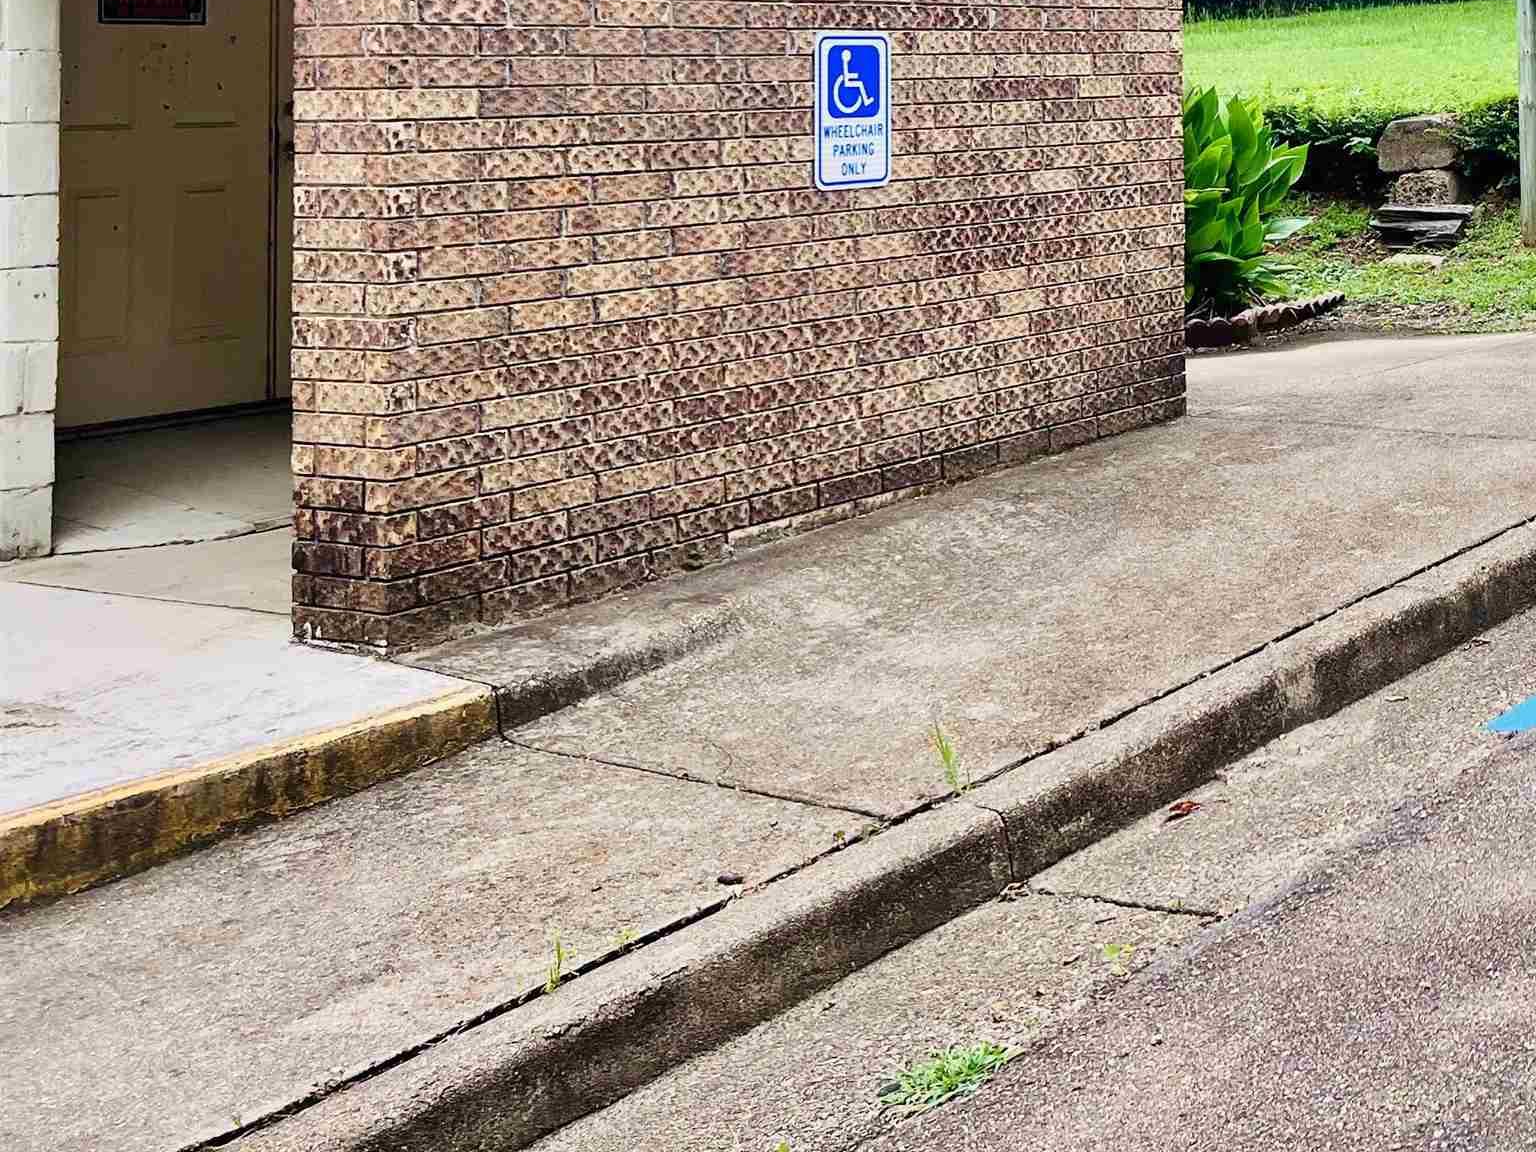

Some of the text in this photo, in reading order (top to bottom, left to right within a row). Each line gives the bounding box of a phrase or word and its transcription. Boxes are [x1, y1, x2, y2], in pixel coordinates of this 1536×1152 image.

[824, 124, 883, 139] WHEELCHAIR
[833, 143, 874, 156] PARKING
[841, 162, 866, 176] ONLY
